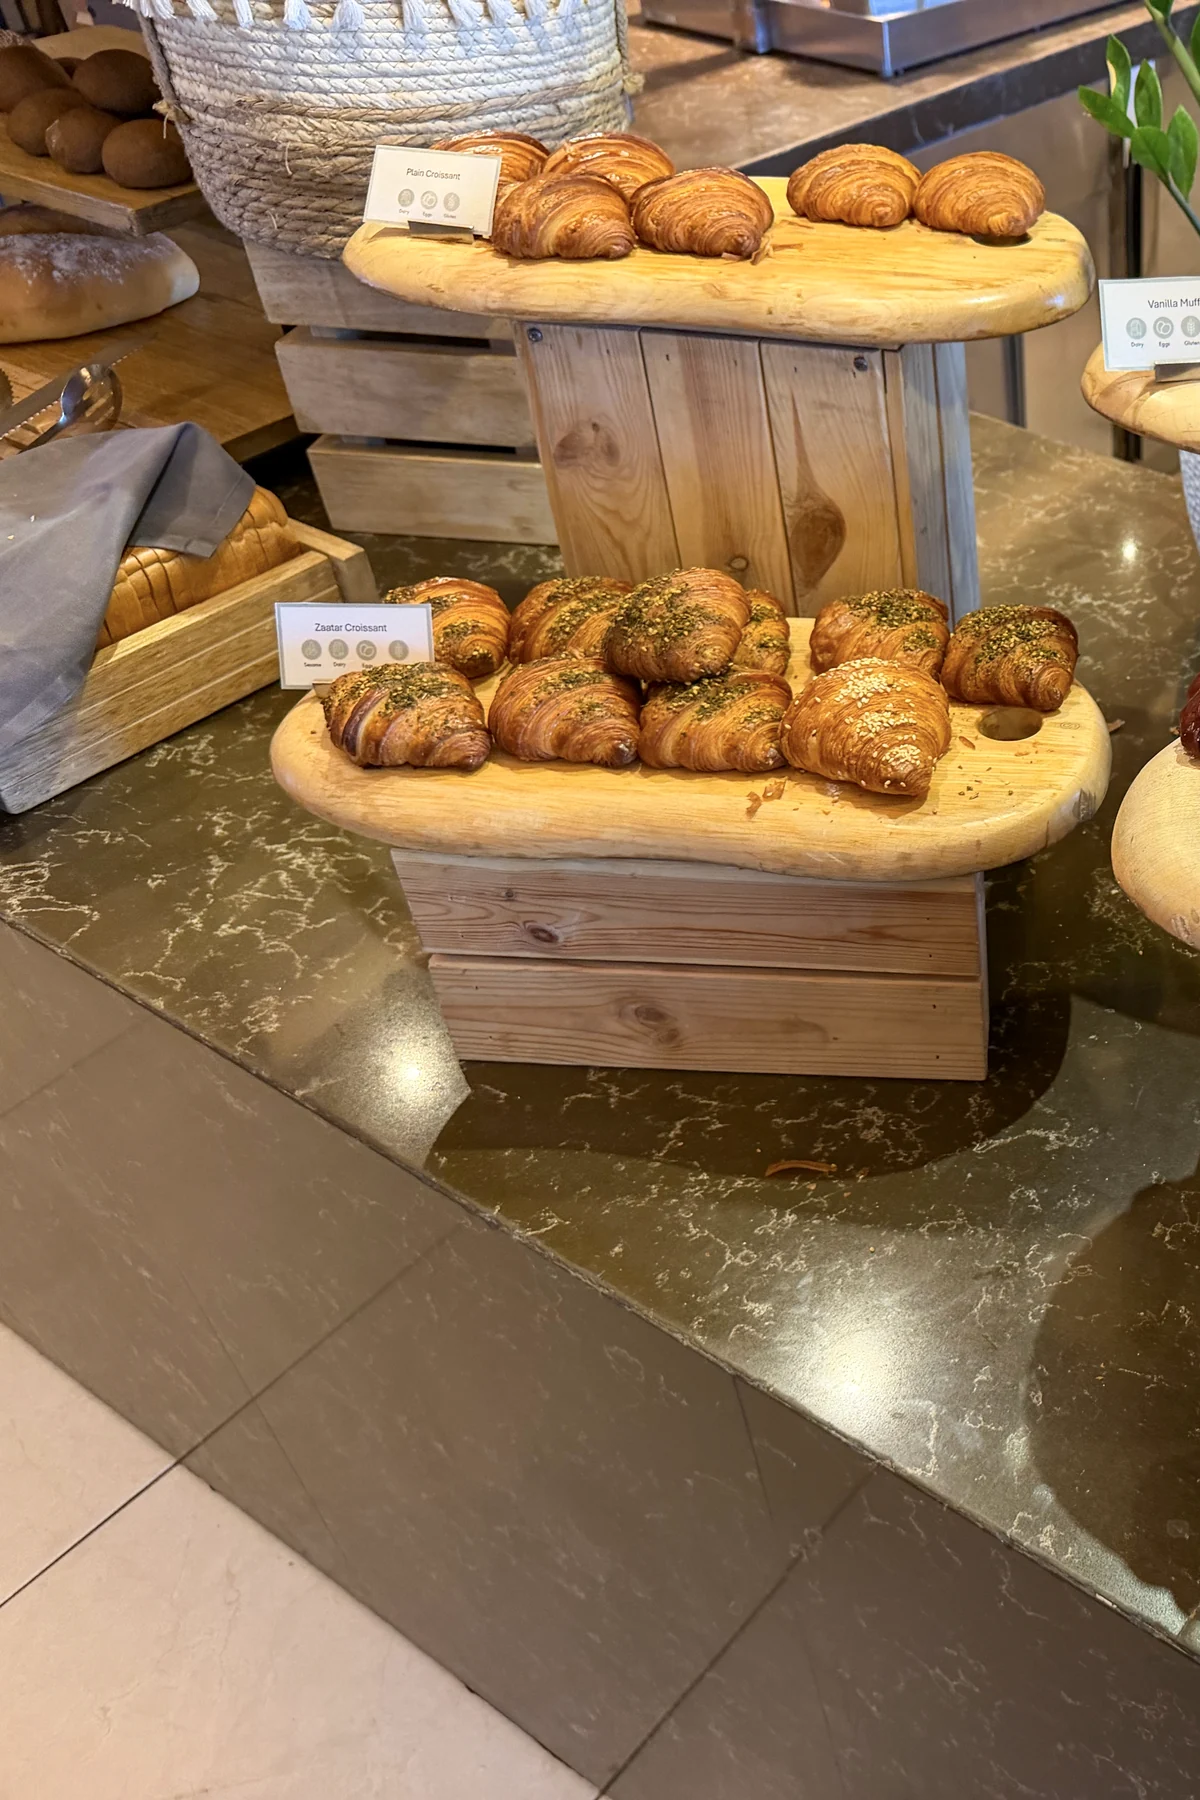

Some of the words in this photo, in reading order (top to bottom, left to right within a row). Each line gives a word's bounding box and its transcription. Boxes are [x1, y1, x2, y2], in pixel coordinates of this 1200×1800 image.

[406, 168, 424, 176] Plain
[425, 170, 460, 180] Croissant
[1148, 299, 1178, 308] Vanilla
[315, 623, 342, 632] Zaatar
[344, 623, 388, 632] Croissant
